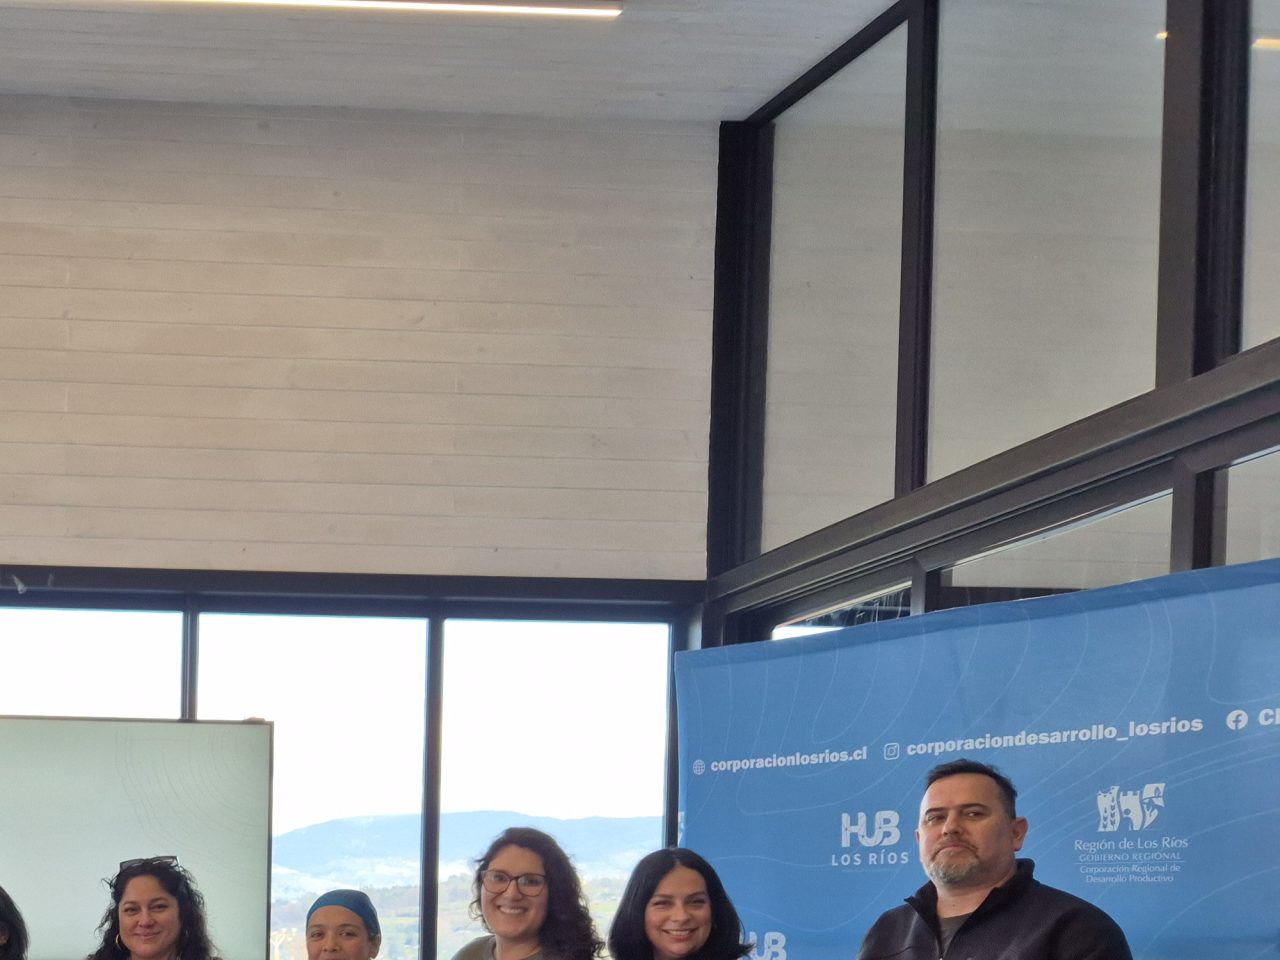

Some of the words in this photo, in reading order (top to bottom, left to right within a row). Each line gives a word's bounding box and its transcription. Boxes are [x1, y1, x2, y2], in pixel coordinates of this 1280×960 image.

[907, 717, 1204, 755] corporaciondesarrollo_losrios
[710, 746, 867, 772] corporacionlosrios.cl
[841, 810, 901, 848] HUB
[1074, 838, 1115, 853] Región
[1118, 837, 1135, 850] de
[1137, 838, 1159, 849] Los
[1162, 836, 1189, 848] Ríos
[831, 853, 862, 867] LOS
[868, 849, 909, 865] RÍOS
[1079, 853, 1129, 862] GOBIERNO
[1132, 852, 1182, 861] REGIONAL
[1080, 865, 1130, 875] Corporación
[1131, 863, 1168, 874] Regional
[1169, 863, 1181, 872] de
[1129, 874, 1174, 882] Productivo
